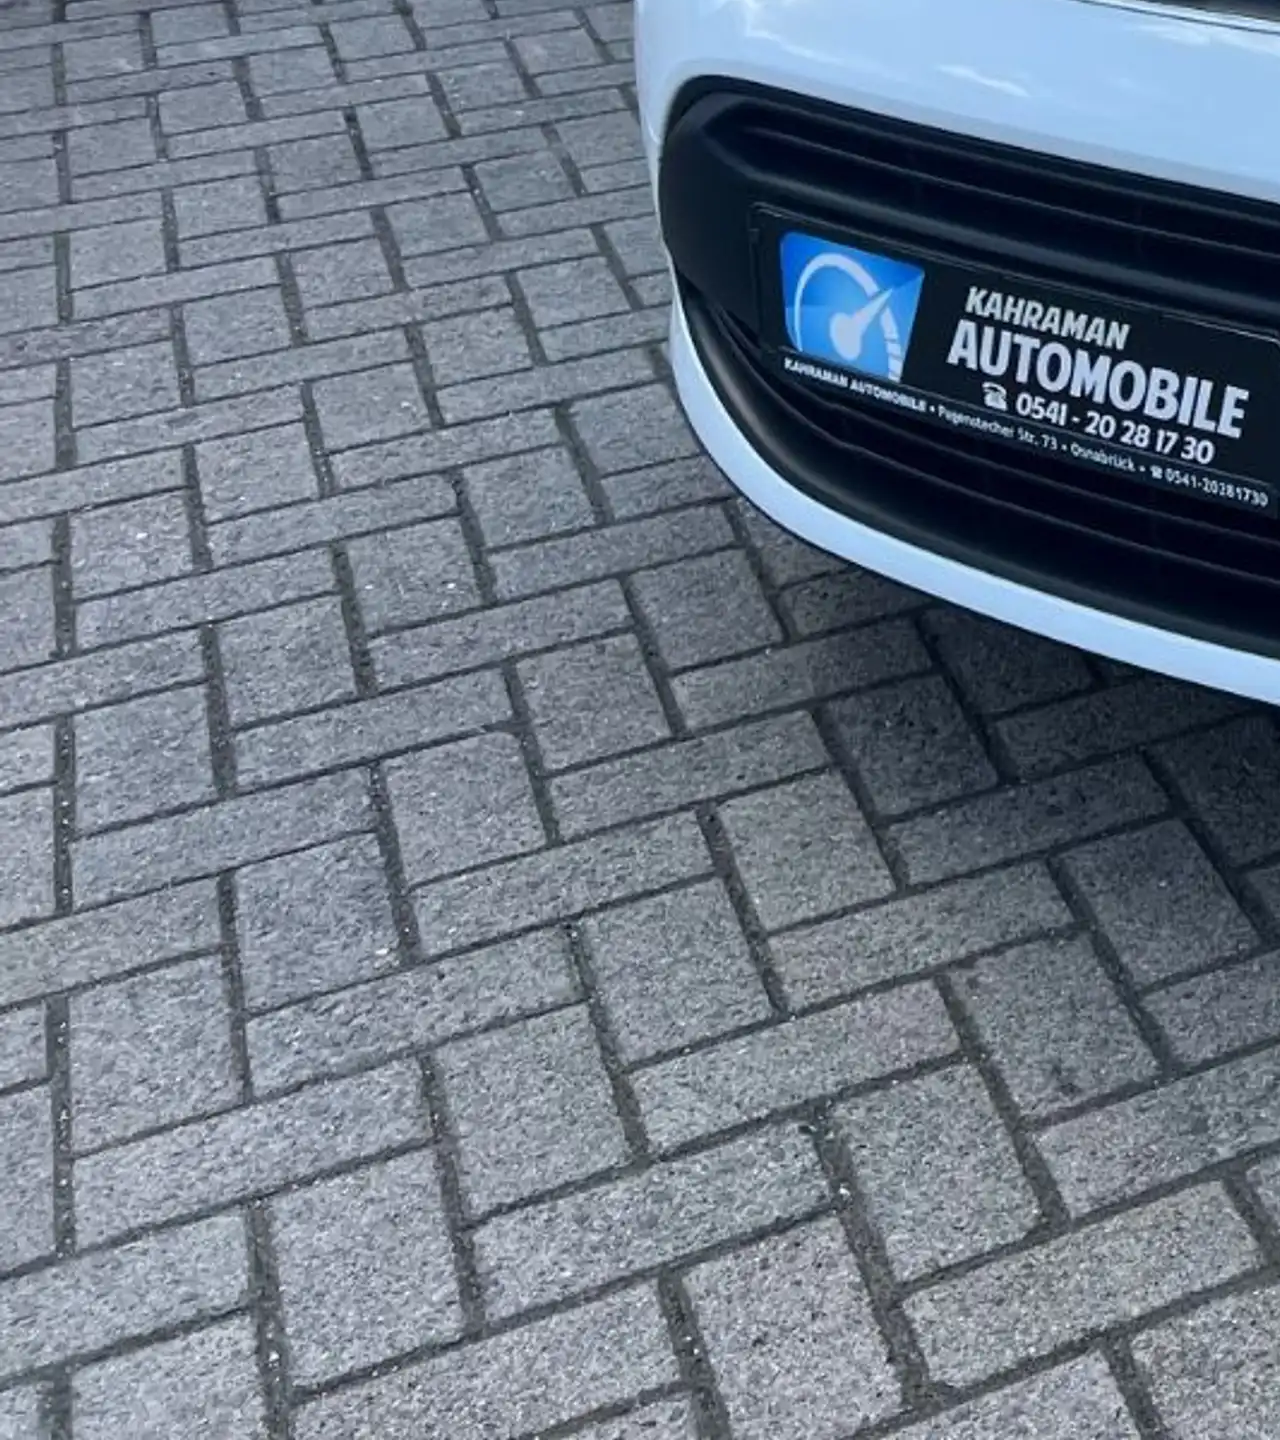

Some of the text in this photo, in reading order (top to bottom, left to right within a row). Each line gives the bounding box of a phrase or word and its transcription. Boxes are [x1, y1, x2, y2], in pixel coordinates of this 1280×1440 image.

[965, 286, 1130, 351] KAHRAMAN
[784, 357, 849, 389] KAHRAMAN
[849, 378, 928, 413] AUTOMOBILE
[1041, 434, 1059, 452] 73
[1070, 442, 1137, 473] Osnabrück
[946, 319, 1249, 439] AUTOMOBILE
[1016, 392, 1068, 426] 0541
[1084, 410, 1117, 439] 20
[1120, 420, 1150, 448] 28
[1156, 429, 1180, 455] 17
[1181, 436, 1215, 465] 30
